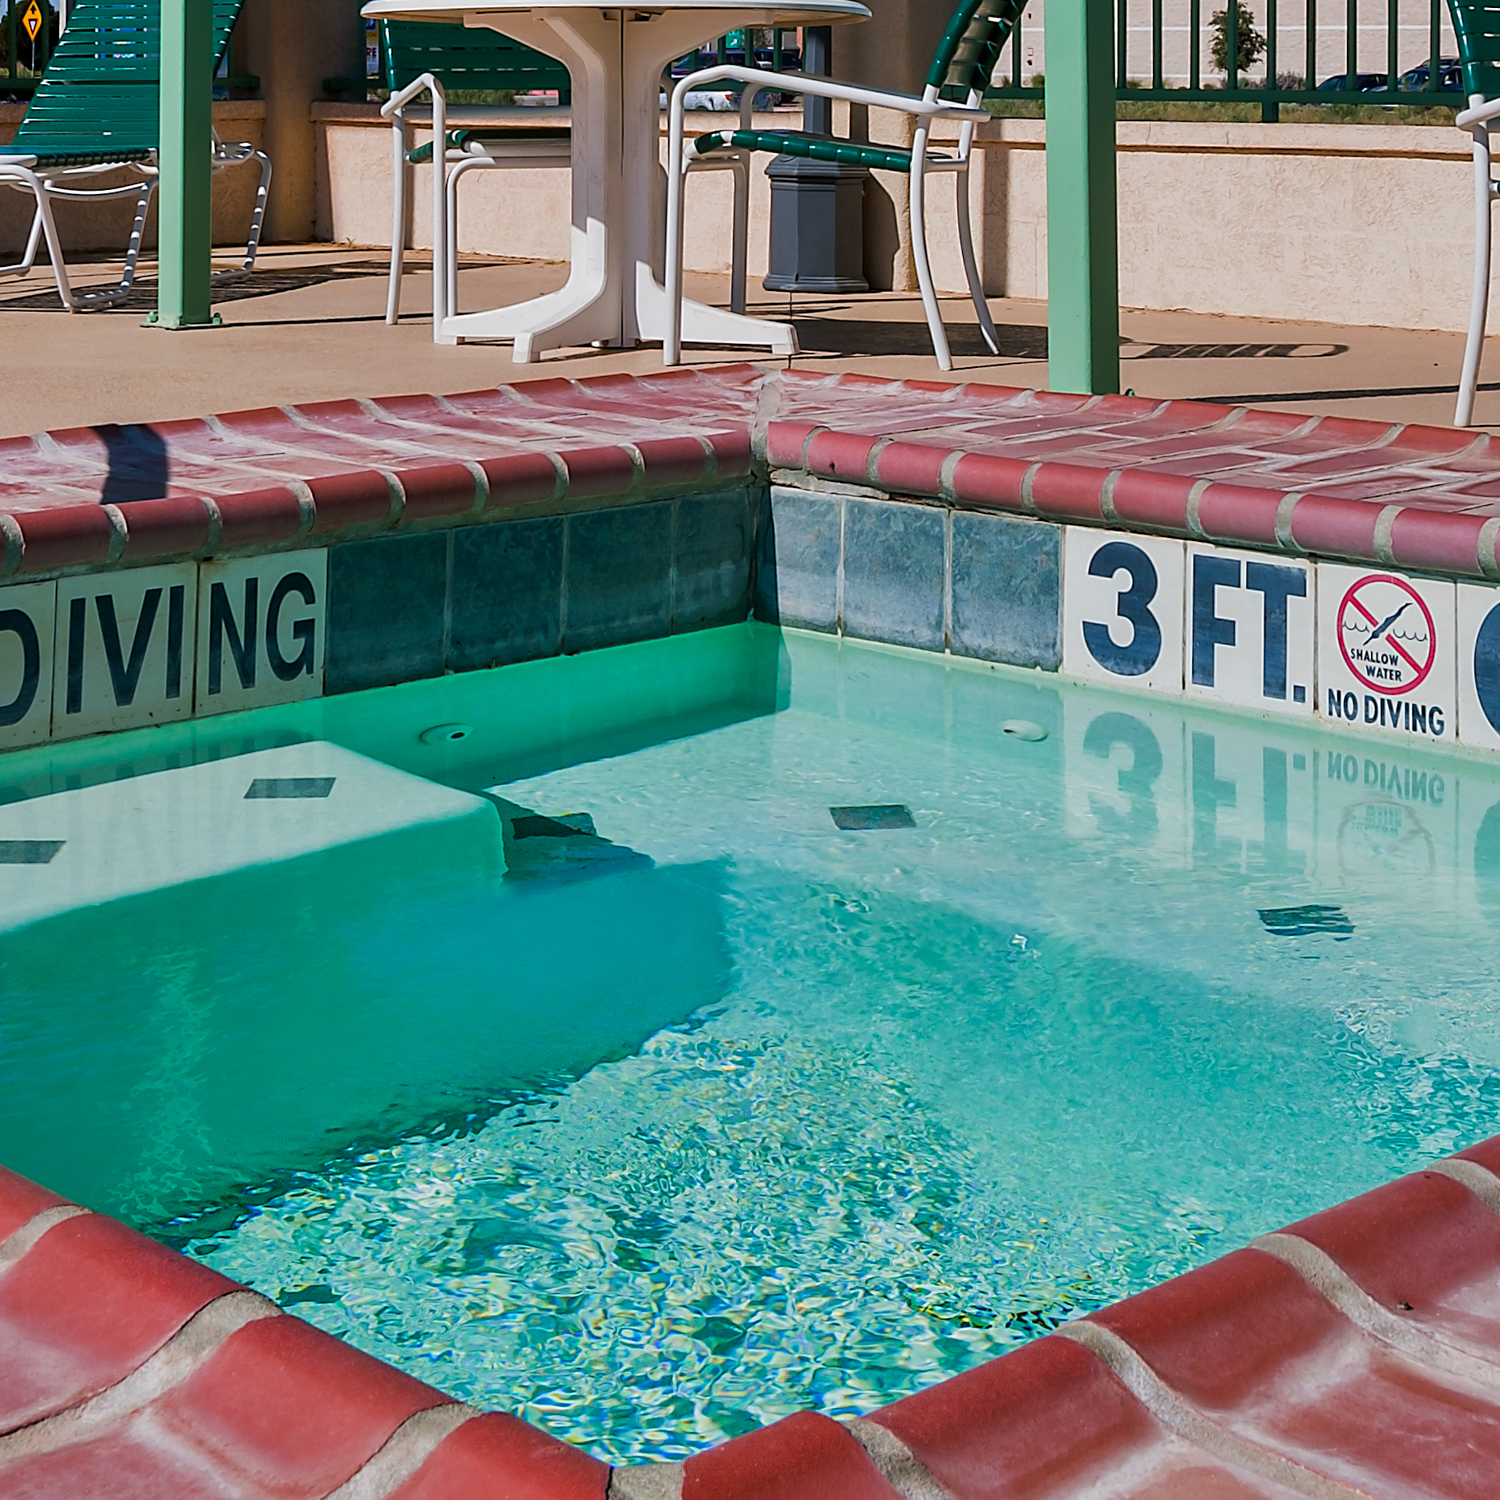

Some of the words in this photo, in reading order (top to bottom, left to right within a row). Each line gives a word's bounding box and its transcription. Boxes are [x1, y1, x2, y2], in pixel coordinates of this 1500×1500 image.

[1082, 541, 1162, 676] 3
[1191, 555, 1307, 703] FT.
[1350, 648, 1399, 665] SHALLOW
[1365, 665, 1402, 682] WATER
[1327, 688, 1359, 721] NO
[1364, 694, 1445, 736] DIVING
